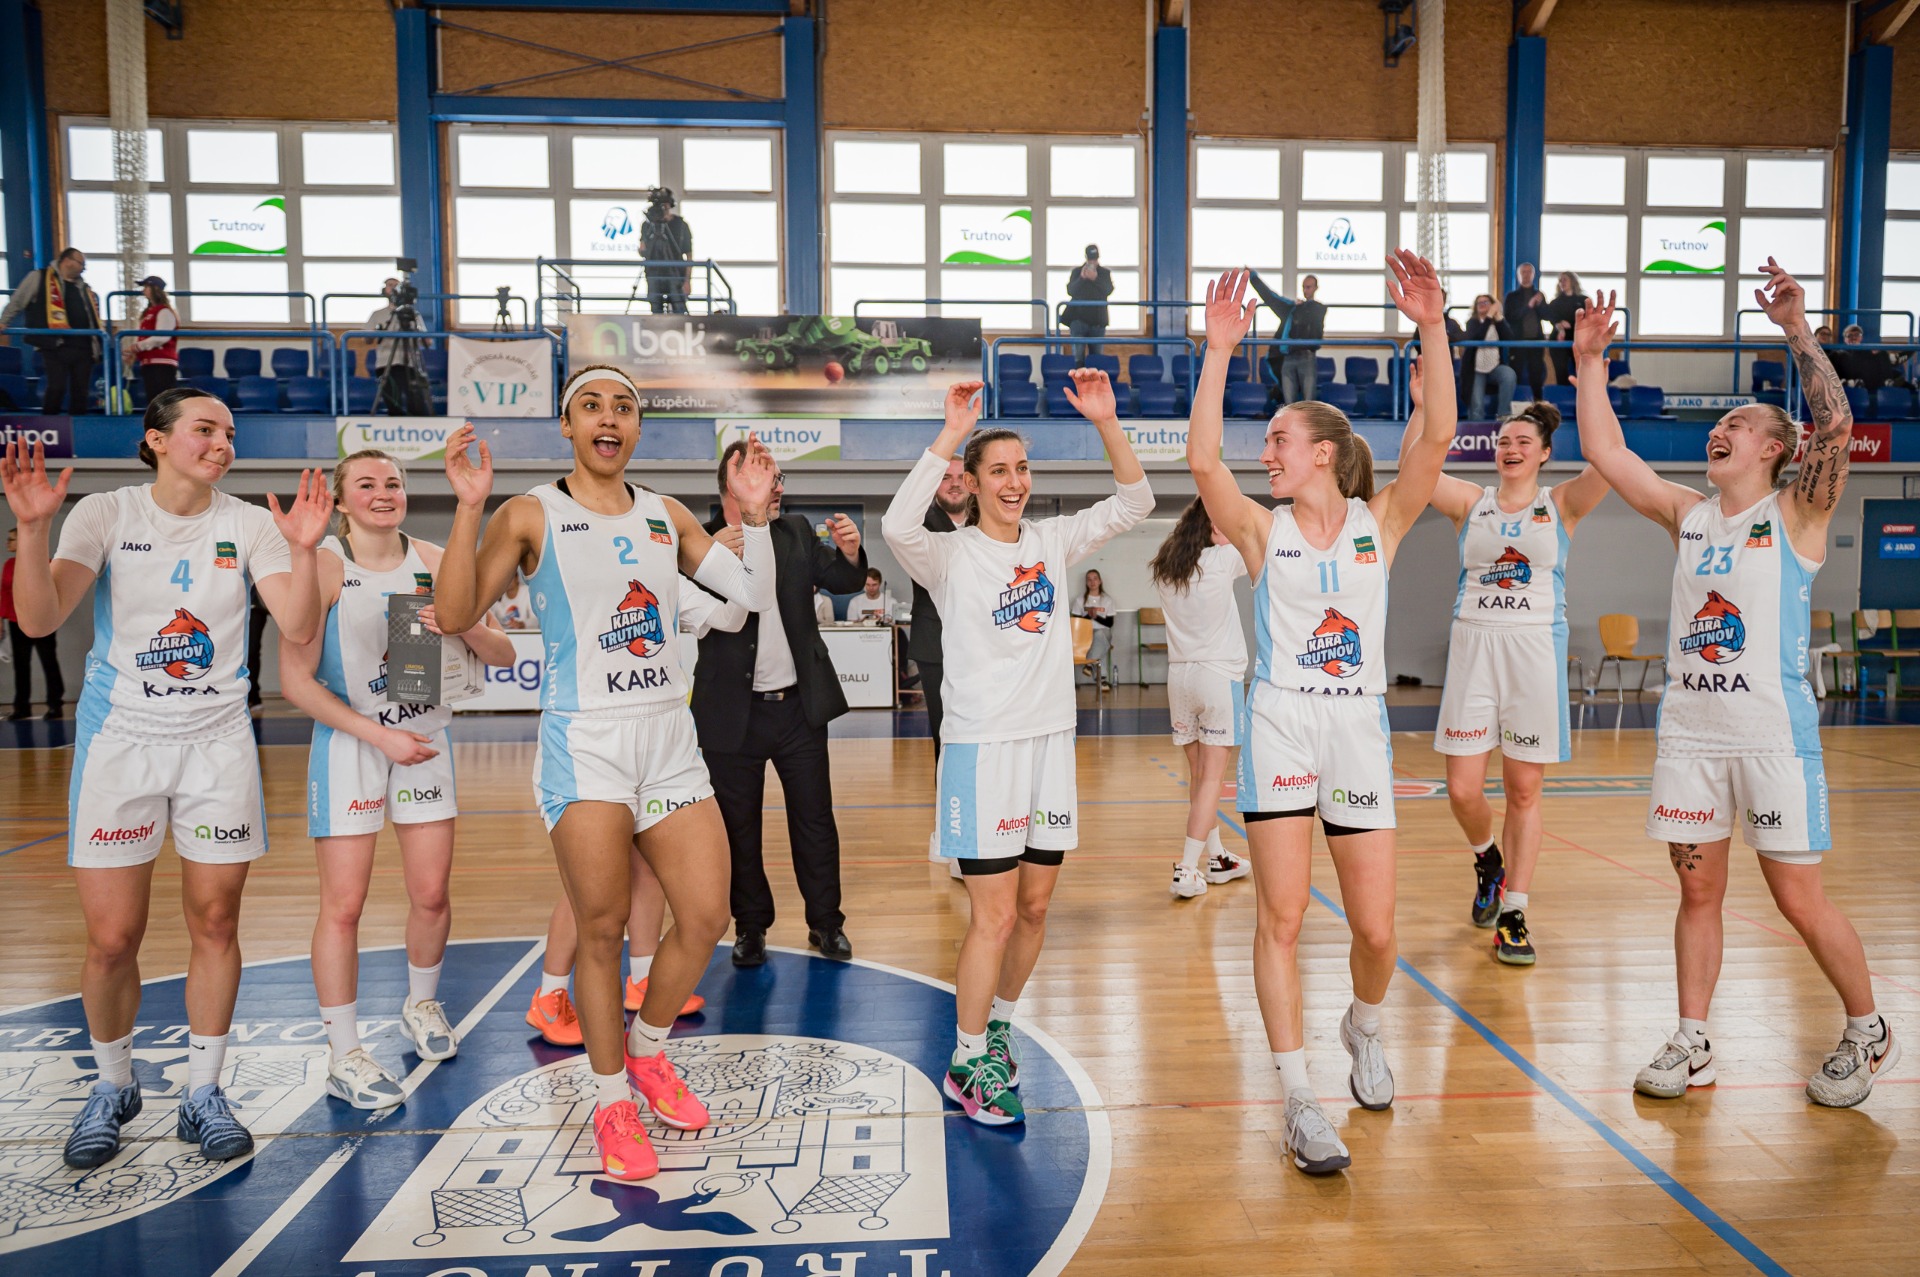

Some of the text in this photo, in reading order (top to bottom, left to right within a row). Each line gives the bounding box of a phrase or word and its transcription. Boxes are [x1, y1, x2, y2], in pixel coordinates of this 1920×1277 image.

[208, 218, 266, 231] Trutnov
[960, 228, 1013, 241] Trutnov
[1659, 239, 1709, 251] Trutnov
[473, 381, 527, 405] VIP
[903, 400, 945, 409] www.ba
[356, 424, 446, 442] Trutnov
[560, 523, 590, 532] JAKO
[1500, 521, 1522, 537] 13
[120, 541, 152, 552] JAKO
[613, 536, 639, 565] 2
[1275, 549, 1301, 558] JAKO
[1696, 544, 1734, 576] 23
[170, 559, 194, 593] 4
[341, 579, 361, 588] AKO
[1317, 560, 1340, 593] 11
[1480, 569, 1524, 582] TRUTNOV
[1001, 582, 1035, 607] KARA
[1478, 596, 1531, 610] KARA
[994, 586, 1049, 624] RUTNOV
[611, 610, 646, 629] KARA
[1690, 619, 1721, 635] KARA
[600, 619, 657, 647] TRUTNOV
[1680, 627, 1735, 650] TRUTNOV
[151, 636, 190, 651] KARA
[1308, 635, 1342, 651] KARA
[136, 645, 204, 666] TRUTNOV
[1297, 643, 1355, 664] TRUTNOV
[607, 667, 672, 693] KARA
[838, 673, 869, 683] BALU
[1683, 673, 1750, 692] KARA
[1445, 727, 1488, 740] Autostyl
[1514, 733, 1540, 746] bak
[414, 786, 442, 801] bak
[1348, 790, 1378, 806] bak
[1816, 772, 1827, 833] trutnov
[950, 796, 961, 837] JAKO
[1654, 804, 1715, 825] Autostyl
[90, 821, 155, 841] Autostyl
[214, 823, 250, 840] bak
